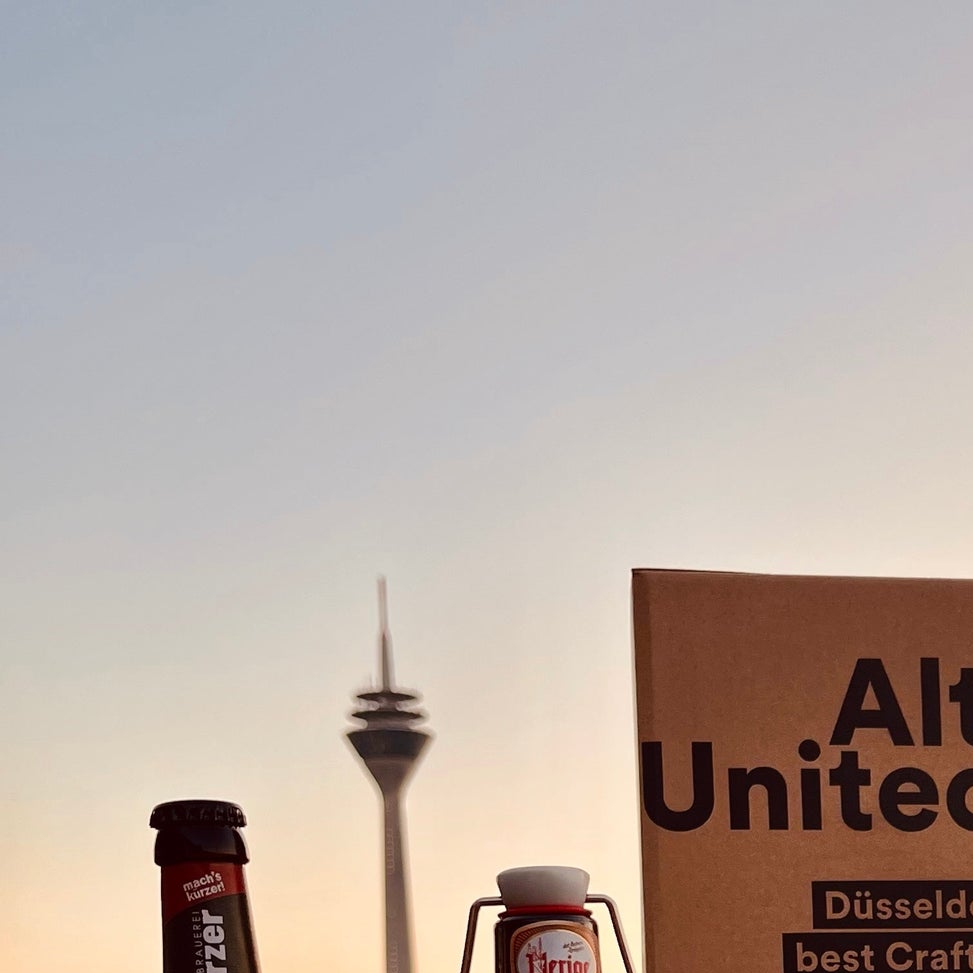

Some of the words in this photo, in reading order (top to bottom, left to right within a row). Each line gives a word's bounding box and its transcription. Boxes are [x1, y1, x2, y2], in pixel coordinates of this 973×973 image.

[183, 871, 222, 892] mach's
[192, 911, 205, 973] BRAUEREI
[795, 942, 875, 973] best
